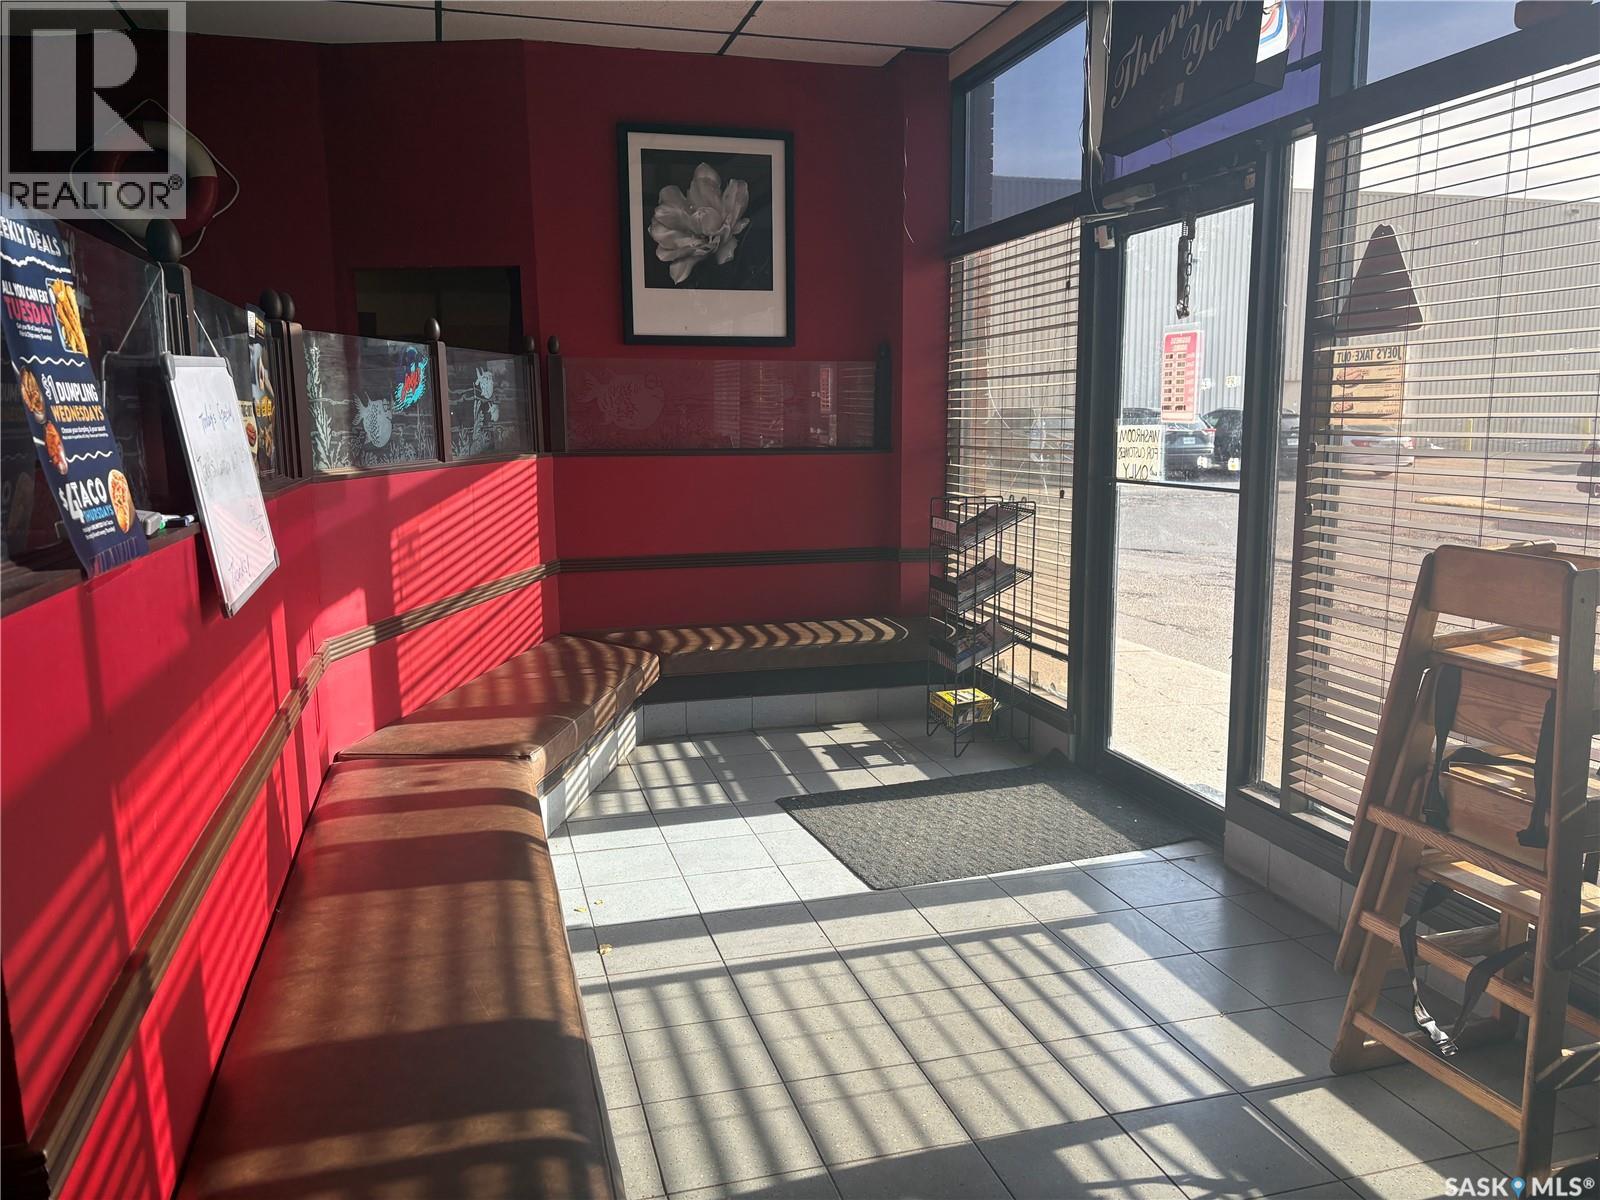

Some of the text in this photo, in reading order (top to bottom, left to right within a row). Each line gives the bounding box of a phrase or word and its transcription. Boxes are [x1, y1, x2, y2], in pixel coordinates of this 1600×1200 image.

[26, 227, 61, 257] DEALS
[2, 280, 49, 304] ALL YOU CAN EAT
[3, 296, 54, 327] TUESDAY
[41, 373, 99, 404] $1 DUMPLING
[51, 405, 105, 422] WEDNESDAYS
[70, 477, 107, 508] TACO
